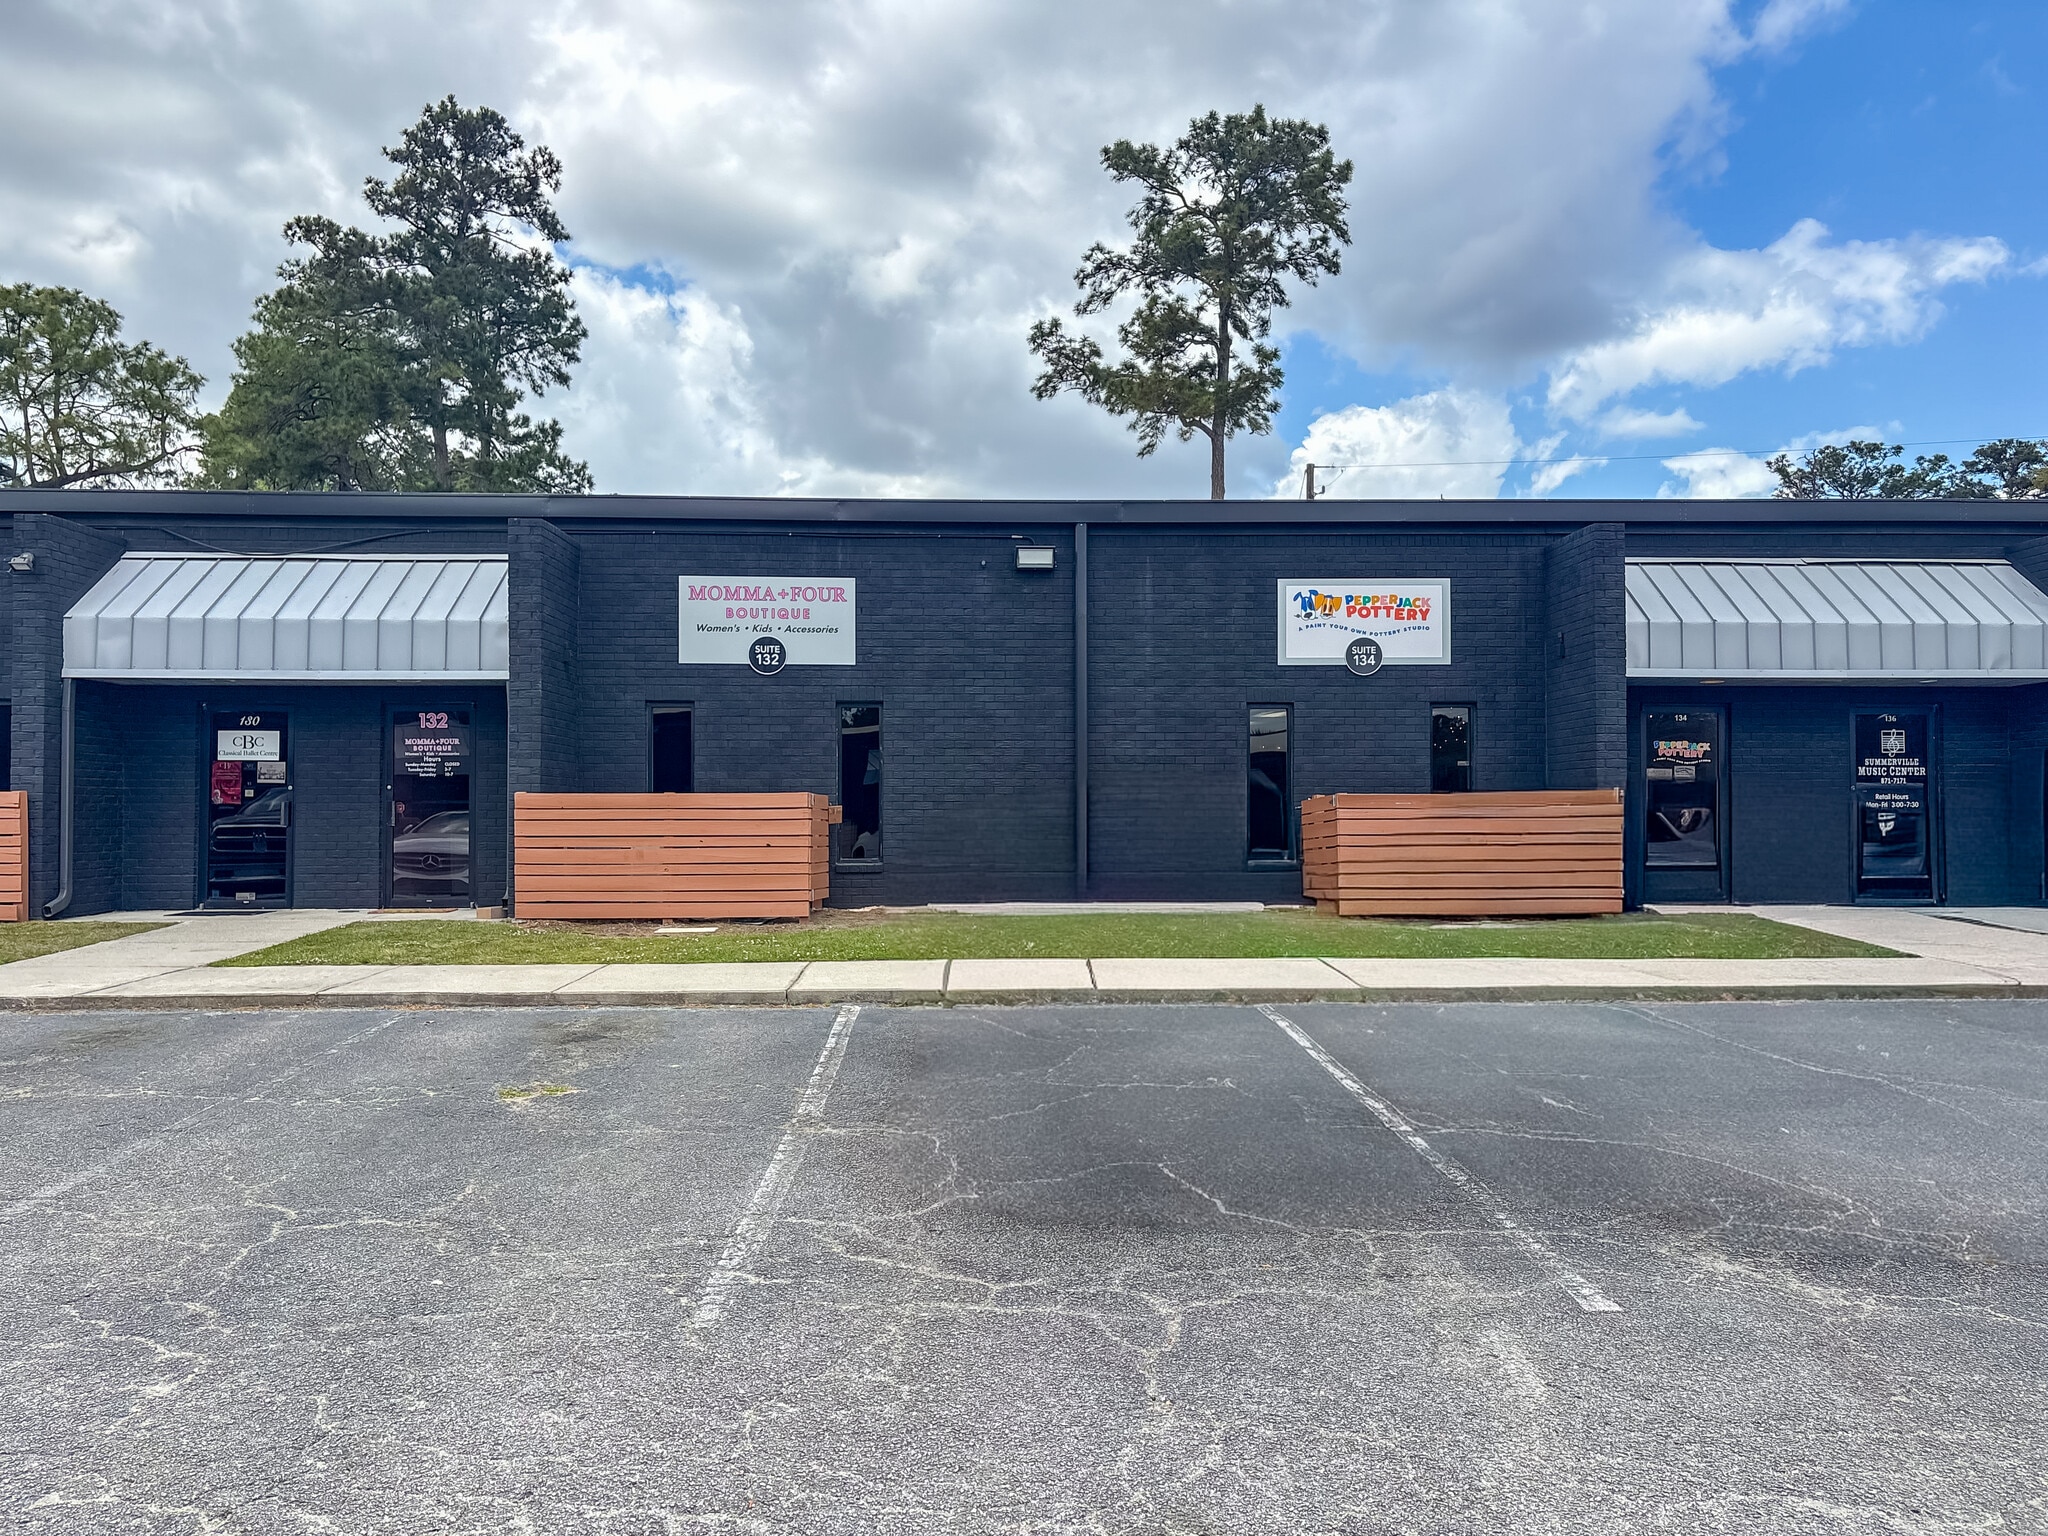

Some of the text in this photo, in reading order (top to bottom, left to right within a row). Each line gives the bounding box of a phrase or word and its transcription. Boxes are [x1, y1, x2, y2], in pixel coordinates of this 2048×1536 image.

[1345, 594, 1431, 608] PEPPERJACK
[726, 607, 810, 619] BOUTIQUE
[1346, 605, 1430, 621] POTTERY
[696, 624, 839, 634] Women's Kids Accessories
[1329, 623, 1348, 631] YOUR
[1350, 628, 1367, 636] OWN
[1369, 628, 1401, 637] POTTERY
[755, 645, 780, 654] SUITE
[1351, 645, 1376, 654] SUITE
[756, 654, 779, 665] 132
[1353, 654, 1375, 666] 134
[419, 712, 448, 728] 132
[1674, 714, 1687, 722] 134
[232, 735, 264, 749] CBC
[1658, 748, 1704, 758] POTTERY
[1864, 758, 1919, 766] SUMMERVILLE
[1858, 766, 1926, 776] MUSIC CENTER
